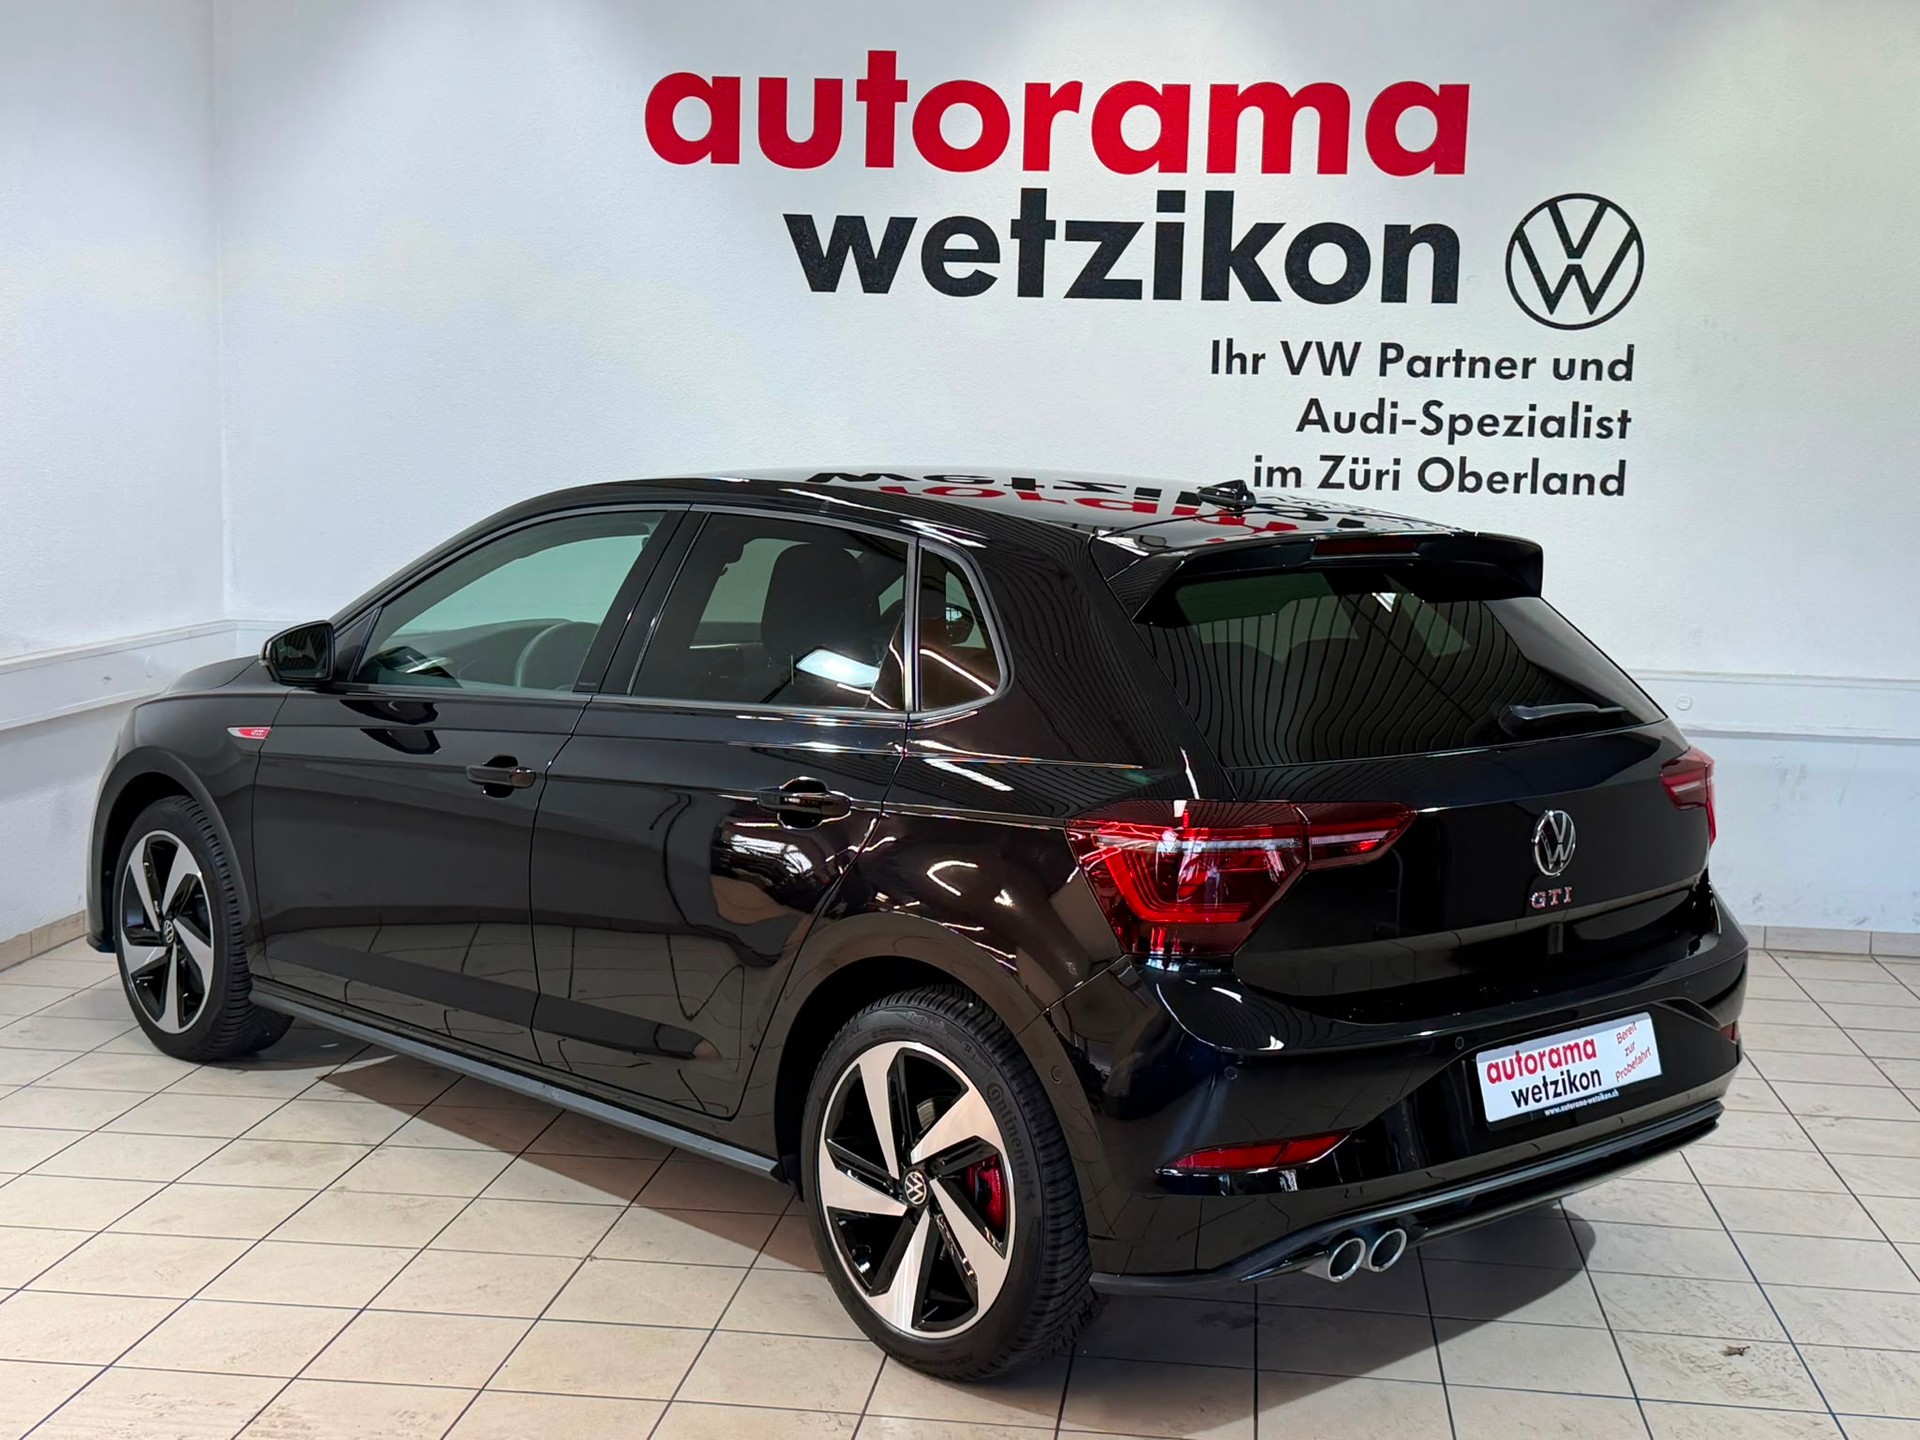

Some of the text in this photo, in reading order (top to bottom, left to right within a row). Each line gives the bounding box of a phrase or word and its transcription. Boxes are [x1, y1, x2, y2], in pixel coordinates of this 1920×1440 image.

[646, 51, 1471, 177] autorama
[783, 188, 1461, 304] wetzikon
[1211, 338, 1635, 381] Ihr VW Partner und
[1296, 398, 1632, 445] Audi-Spezialist
[1254, 454, 1627, 496] im Züri Oberland
[1530, 886, 1573, 909] GTI
[1615, 1020, 1638, 1045] Bereit
[1624, 1041, 1636, 1057] zur
[1486, 1038, 1598, 1085] autorama
[1615, 1046, 1652, 1083] Probefahrt
[1510, 1068, 1603, 1109] wetzikon
[1544, 1088, 1620, 1117] www.autorama-wetzikon.ch
[986, 1082, 1034, 1185] Continental
